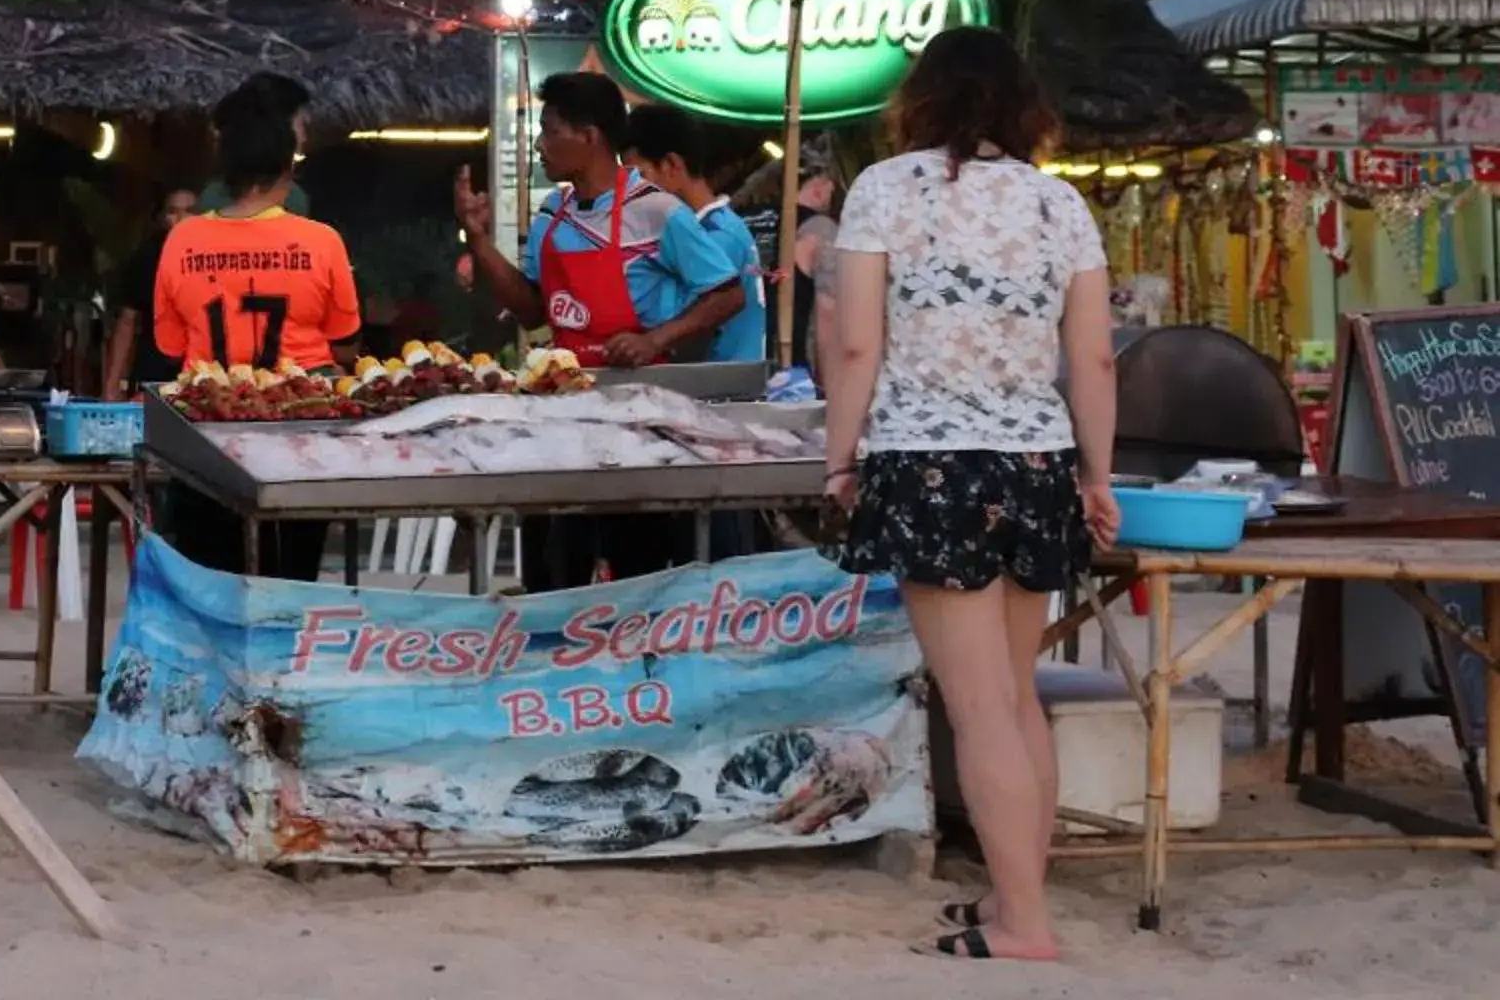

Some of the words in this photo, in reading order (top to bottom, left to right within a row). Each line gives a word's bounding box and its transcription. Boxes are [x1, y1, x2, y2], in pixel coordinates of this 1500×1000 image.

[202, 294, 290, 373] 17
[291, 605, 531, 678] Fresh
[550, 572, 870, 668] Seafood
[497, 680, 673, 736] B.B.Q
